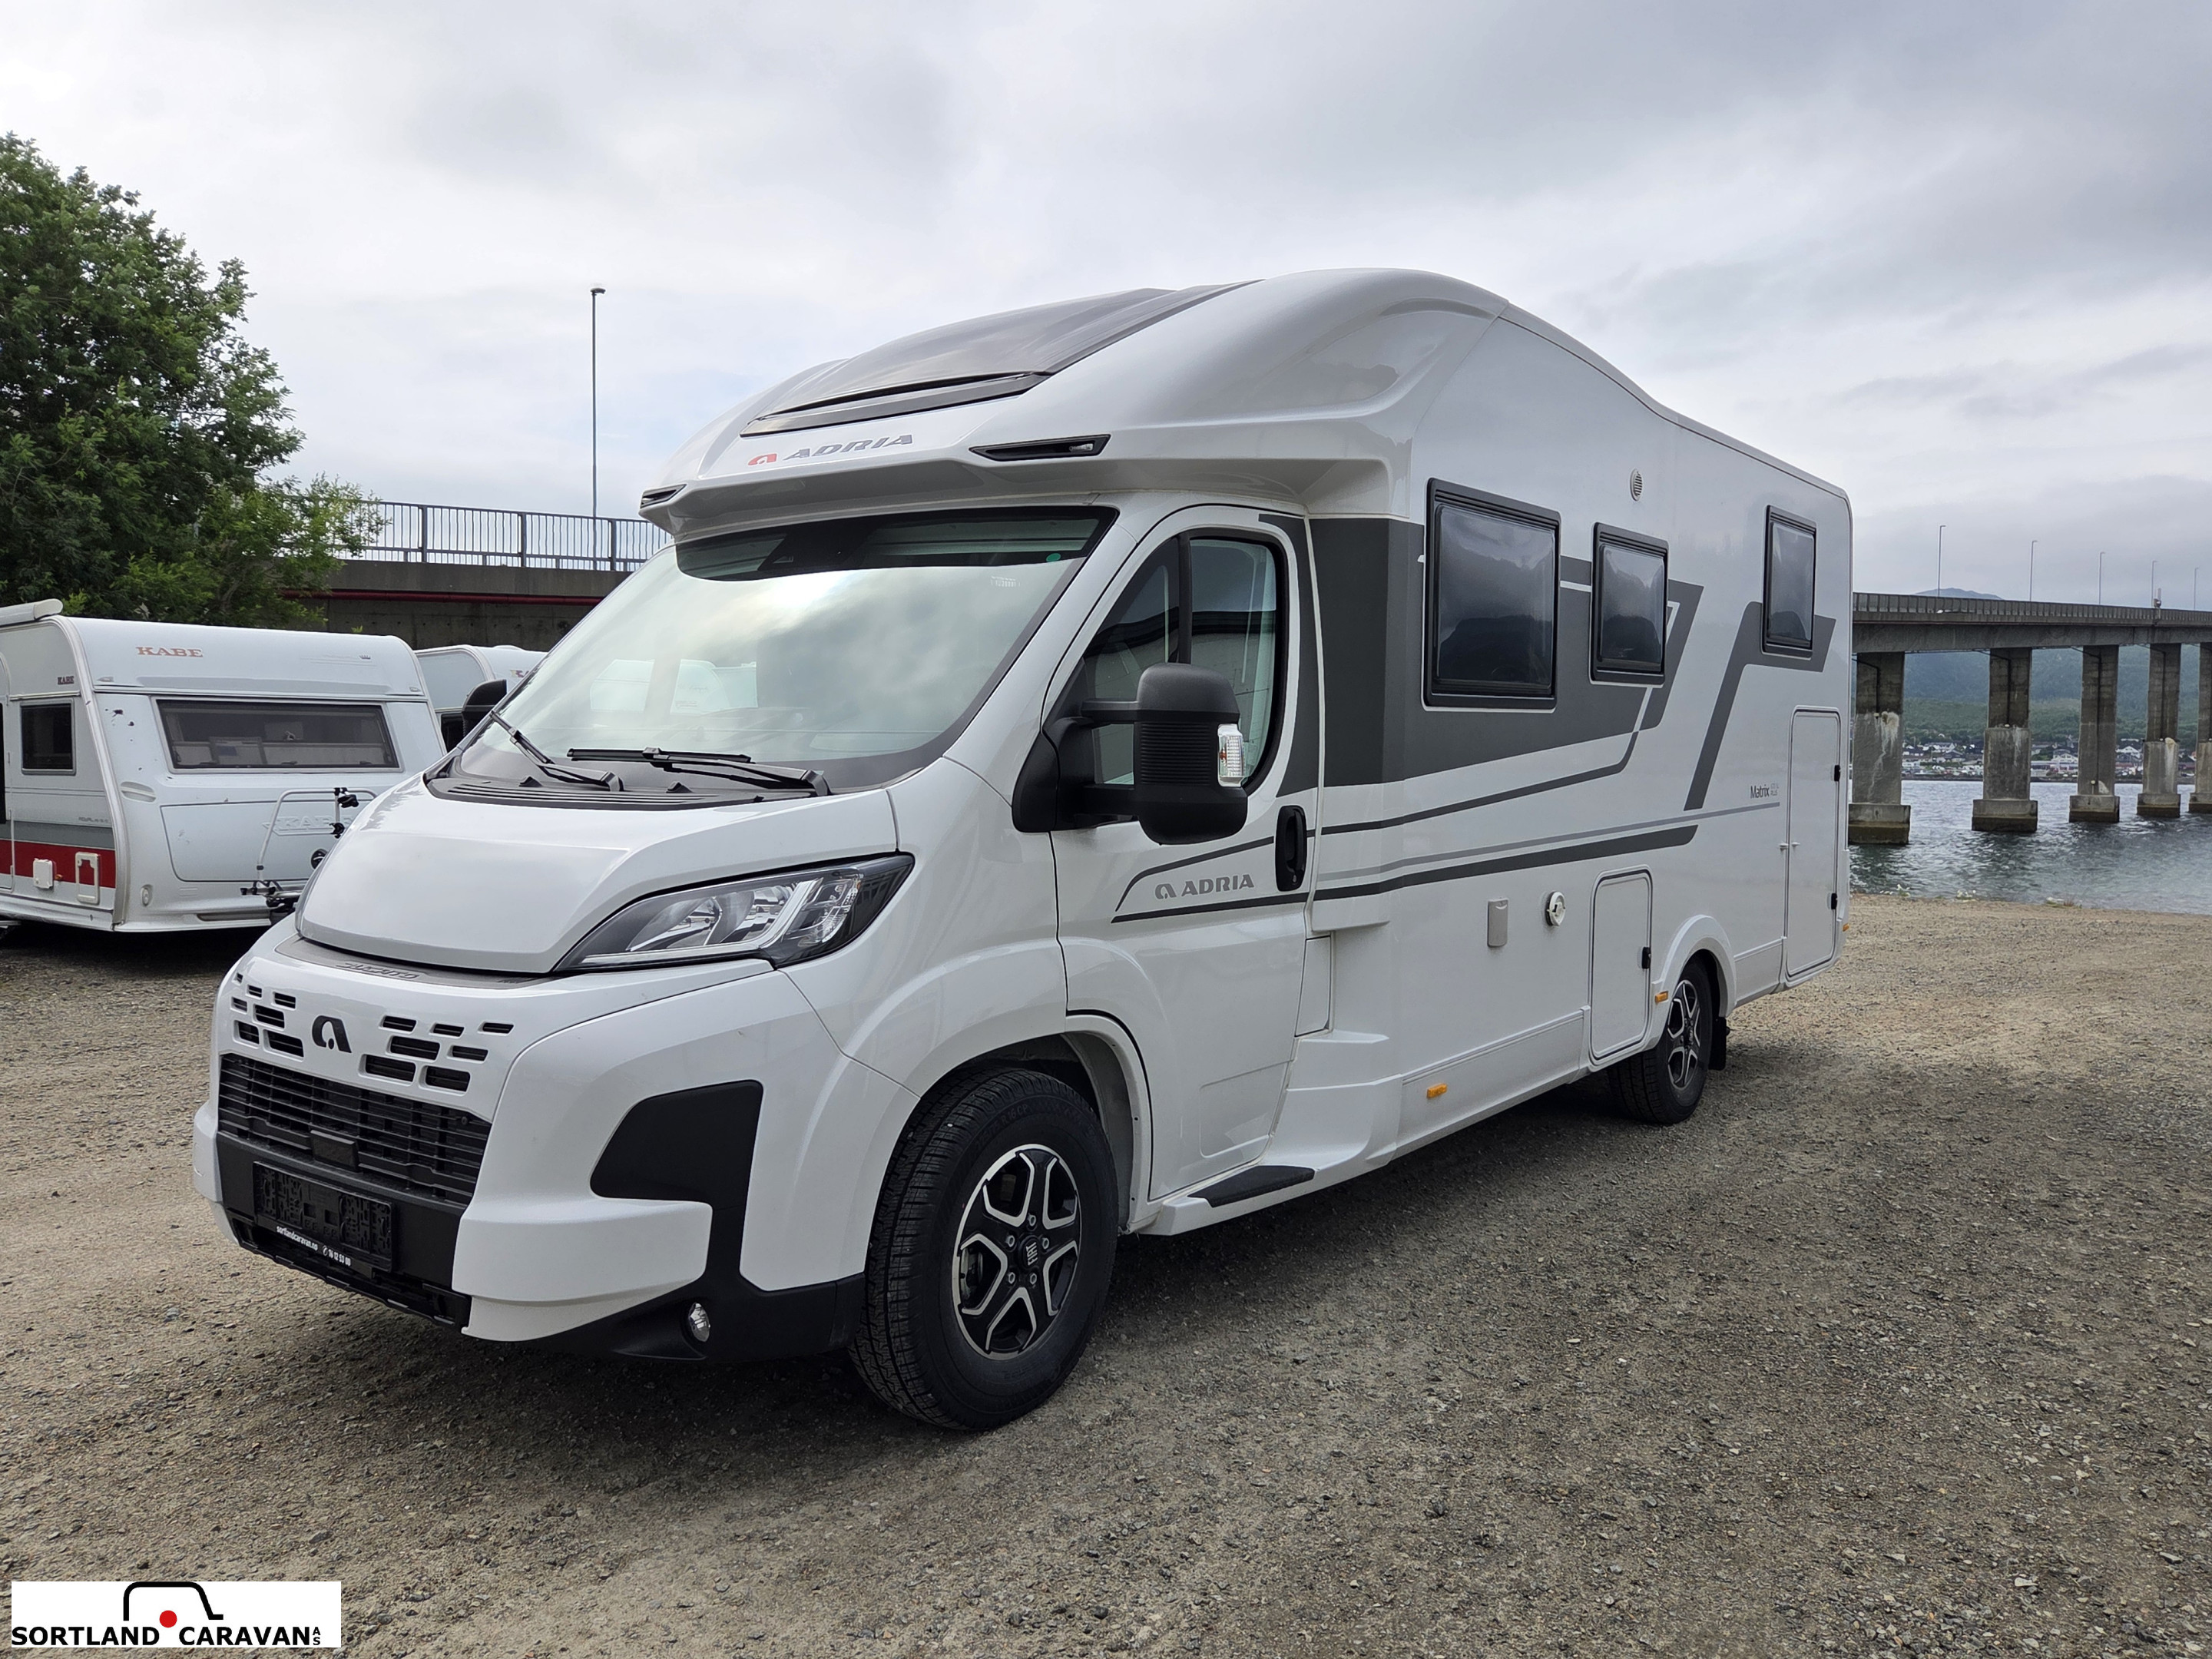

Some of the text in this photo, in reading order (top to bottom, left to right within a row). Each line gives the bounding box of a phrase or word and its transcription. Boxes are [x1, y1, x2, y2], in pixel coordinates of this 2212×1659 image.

[783, 435, 912, 460] ADRIA
[136, 647, 203, 657] KABE
[58, 676, 75, 684] KABE
[1750, 784, 1770, 799] Matrix
[1181, 874, 1254, 897] ADRIA
[1026, 1242, 1038, 1266] FIAT
